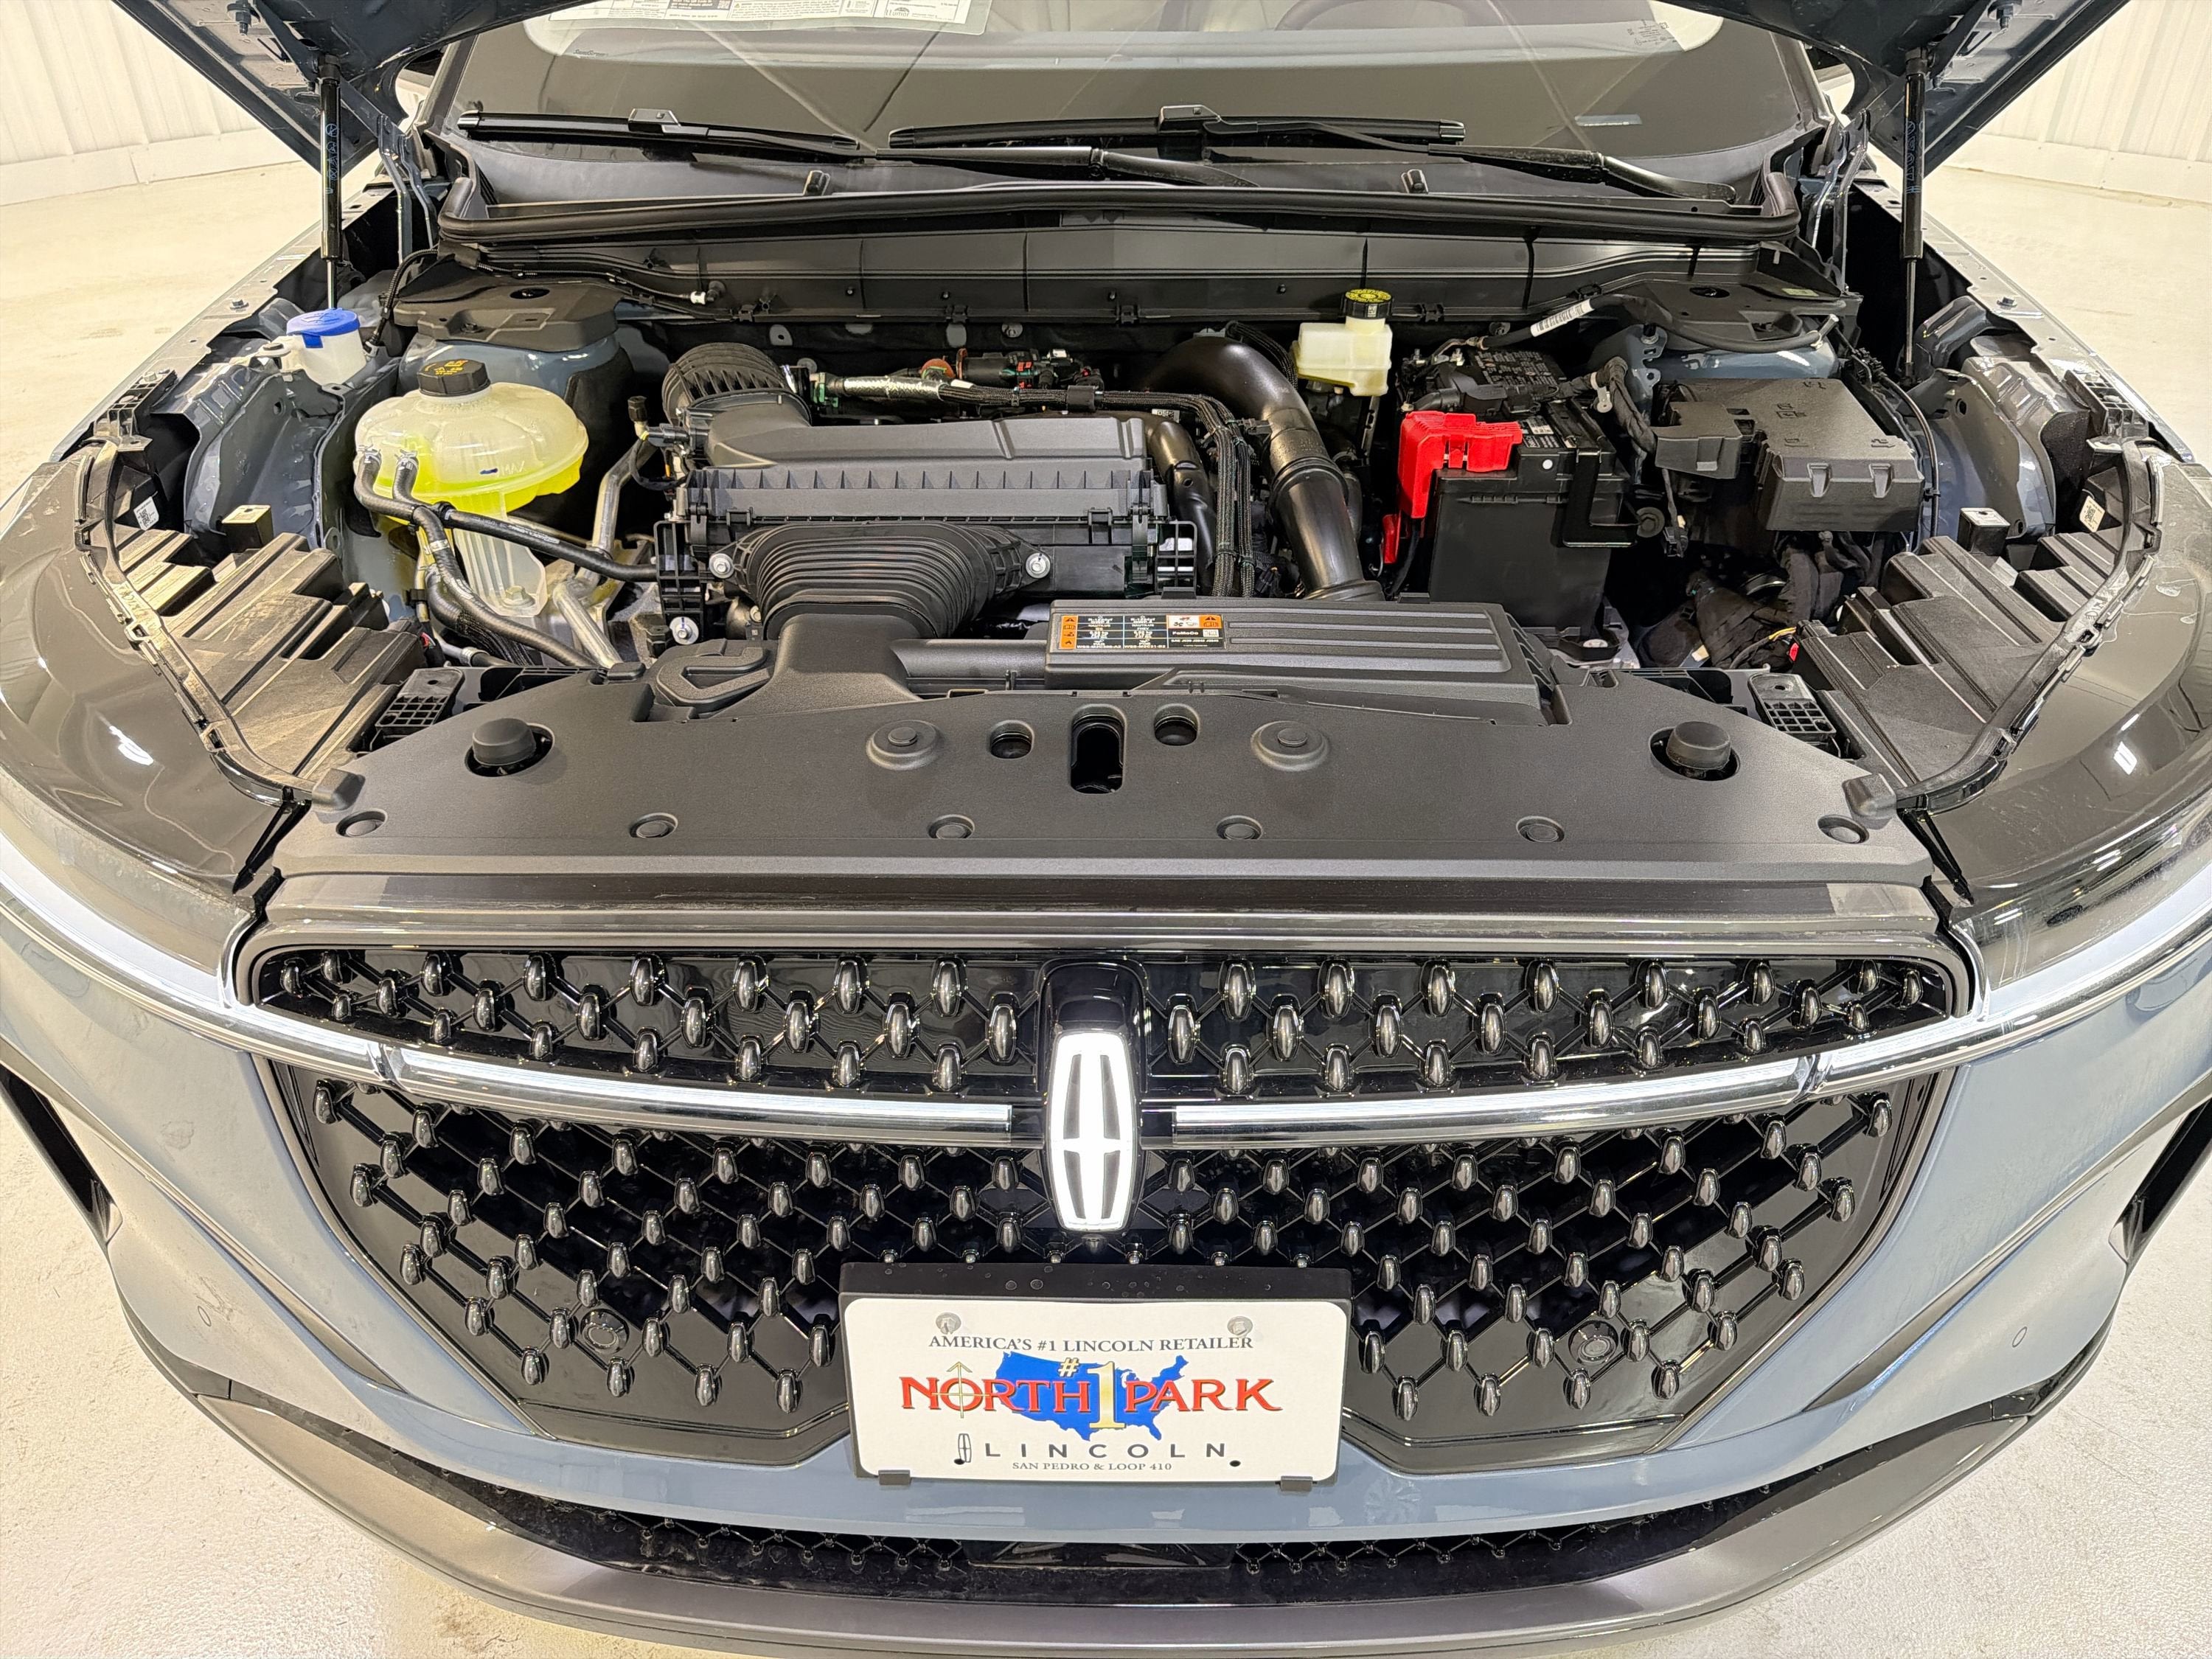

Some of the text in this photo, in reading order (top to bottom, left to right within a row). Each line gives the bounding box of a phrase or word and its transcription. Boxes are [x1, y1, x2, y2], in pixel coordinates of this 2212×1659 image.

[928, 1335, 1253, 1352] AMERICA'S #1 LINCOLN RETAILER
[899, 1376, 1283, 1413] NORTH PARK
[985, 1442, 1225, 1458] LINCOLN
[1012, 1462, 1172, 1471] SAN PEDRO & LOOP 410
